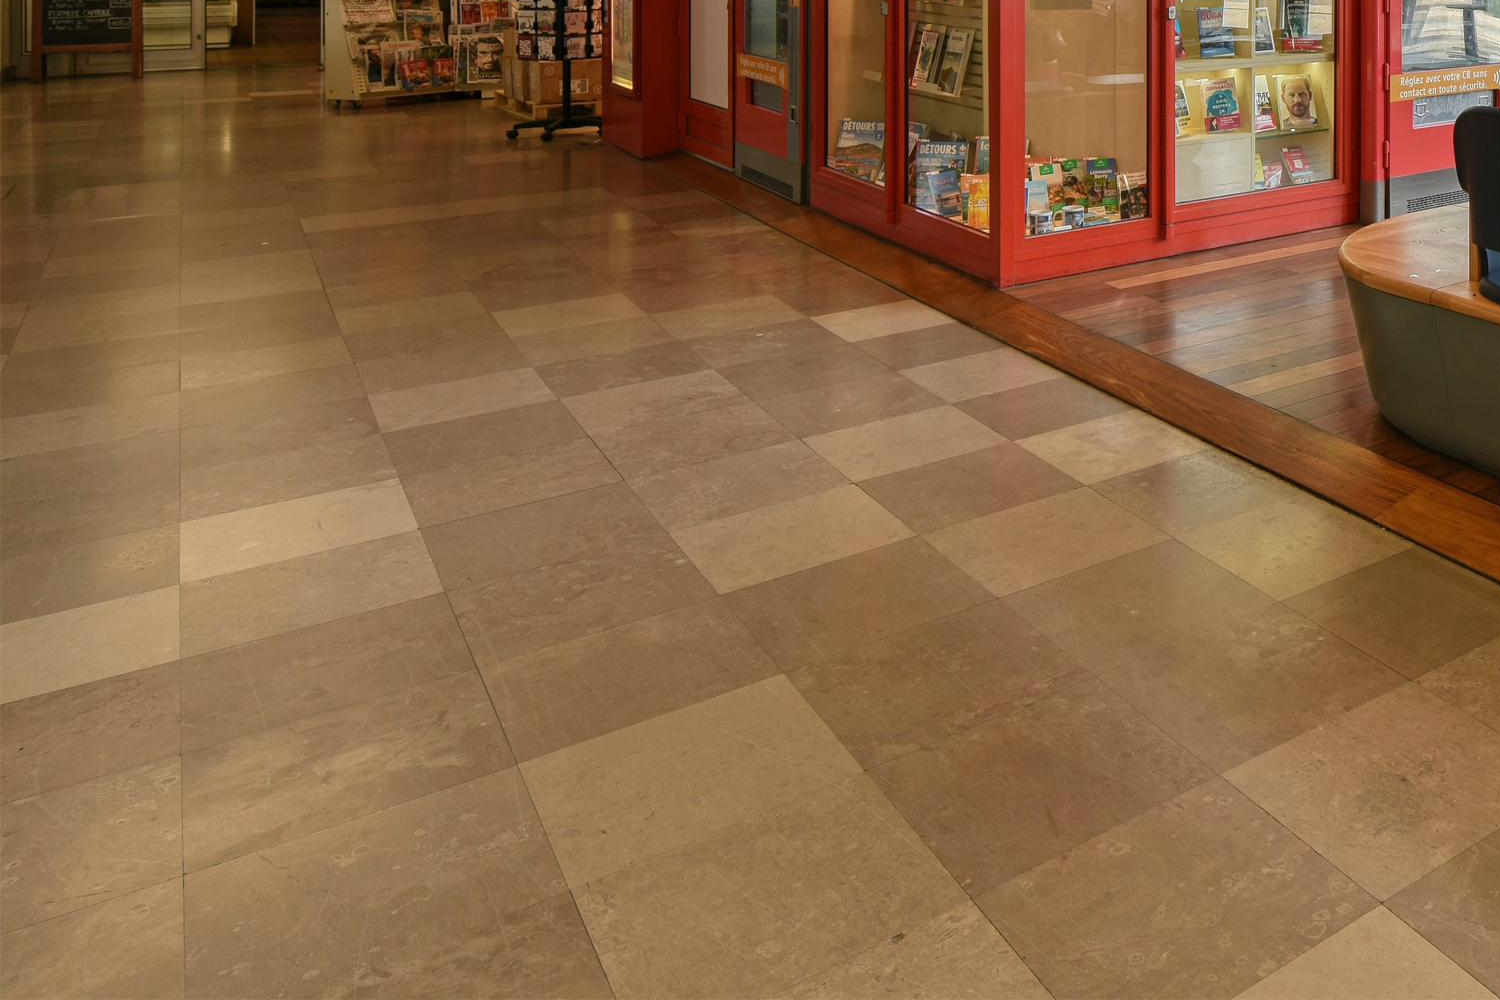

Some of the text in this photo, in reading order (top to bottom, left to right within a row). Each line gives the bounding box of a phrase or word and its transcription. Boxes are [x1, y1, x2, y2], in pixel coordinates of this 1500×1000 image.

[1201, 12, 1223, 20] DUGA
[1401, 70, 1487, 88] Réglez avec votre CB sans
[1206, 83, 1234, 91] GRIMALDI
[1400, 88, 1426, 98] contact
[1439, 84, 1457, 93] toute
[1459, 80, 1487, 91] sécurité.
[843, 121, 876, 131] DÉTOURS
[920, 144, 956, 155] DÉTOURS
[1029, 185, 1045, 194] gnol
